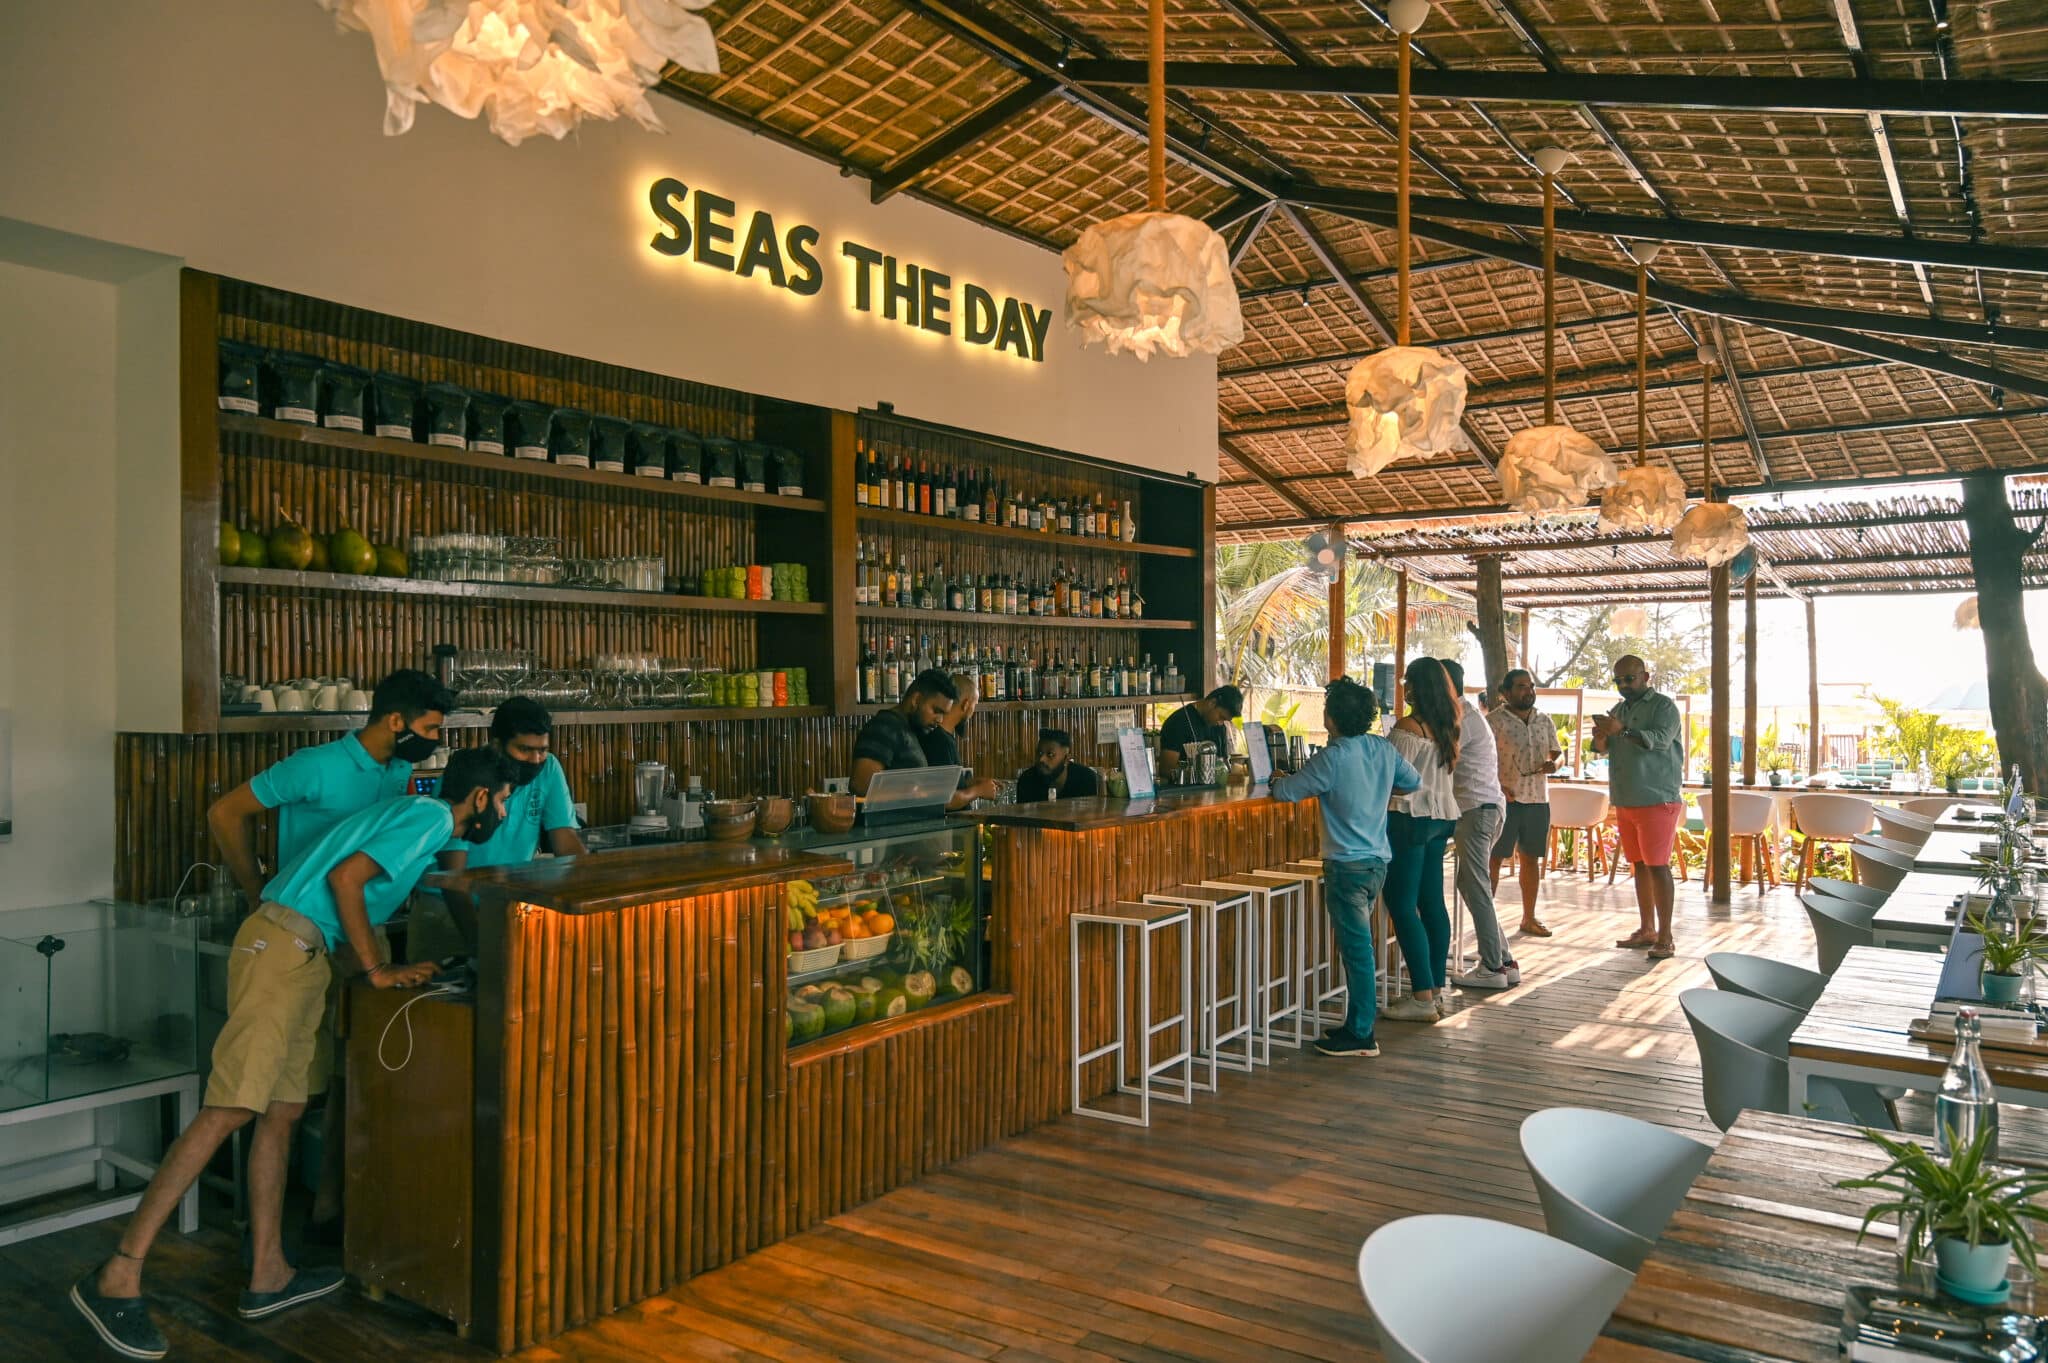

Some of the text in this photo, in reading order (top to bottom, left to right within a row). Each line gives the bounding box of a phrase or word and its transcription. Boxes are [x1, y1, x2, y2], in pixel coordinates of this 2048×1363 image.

[650, 178, 1052, 362] SEAS THE DAY
